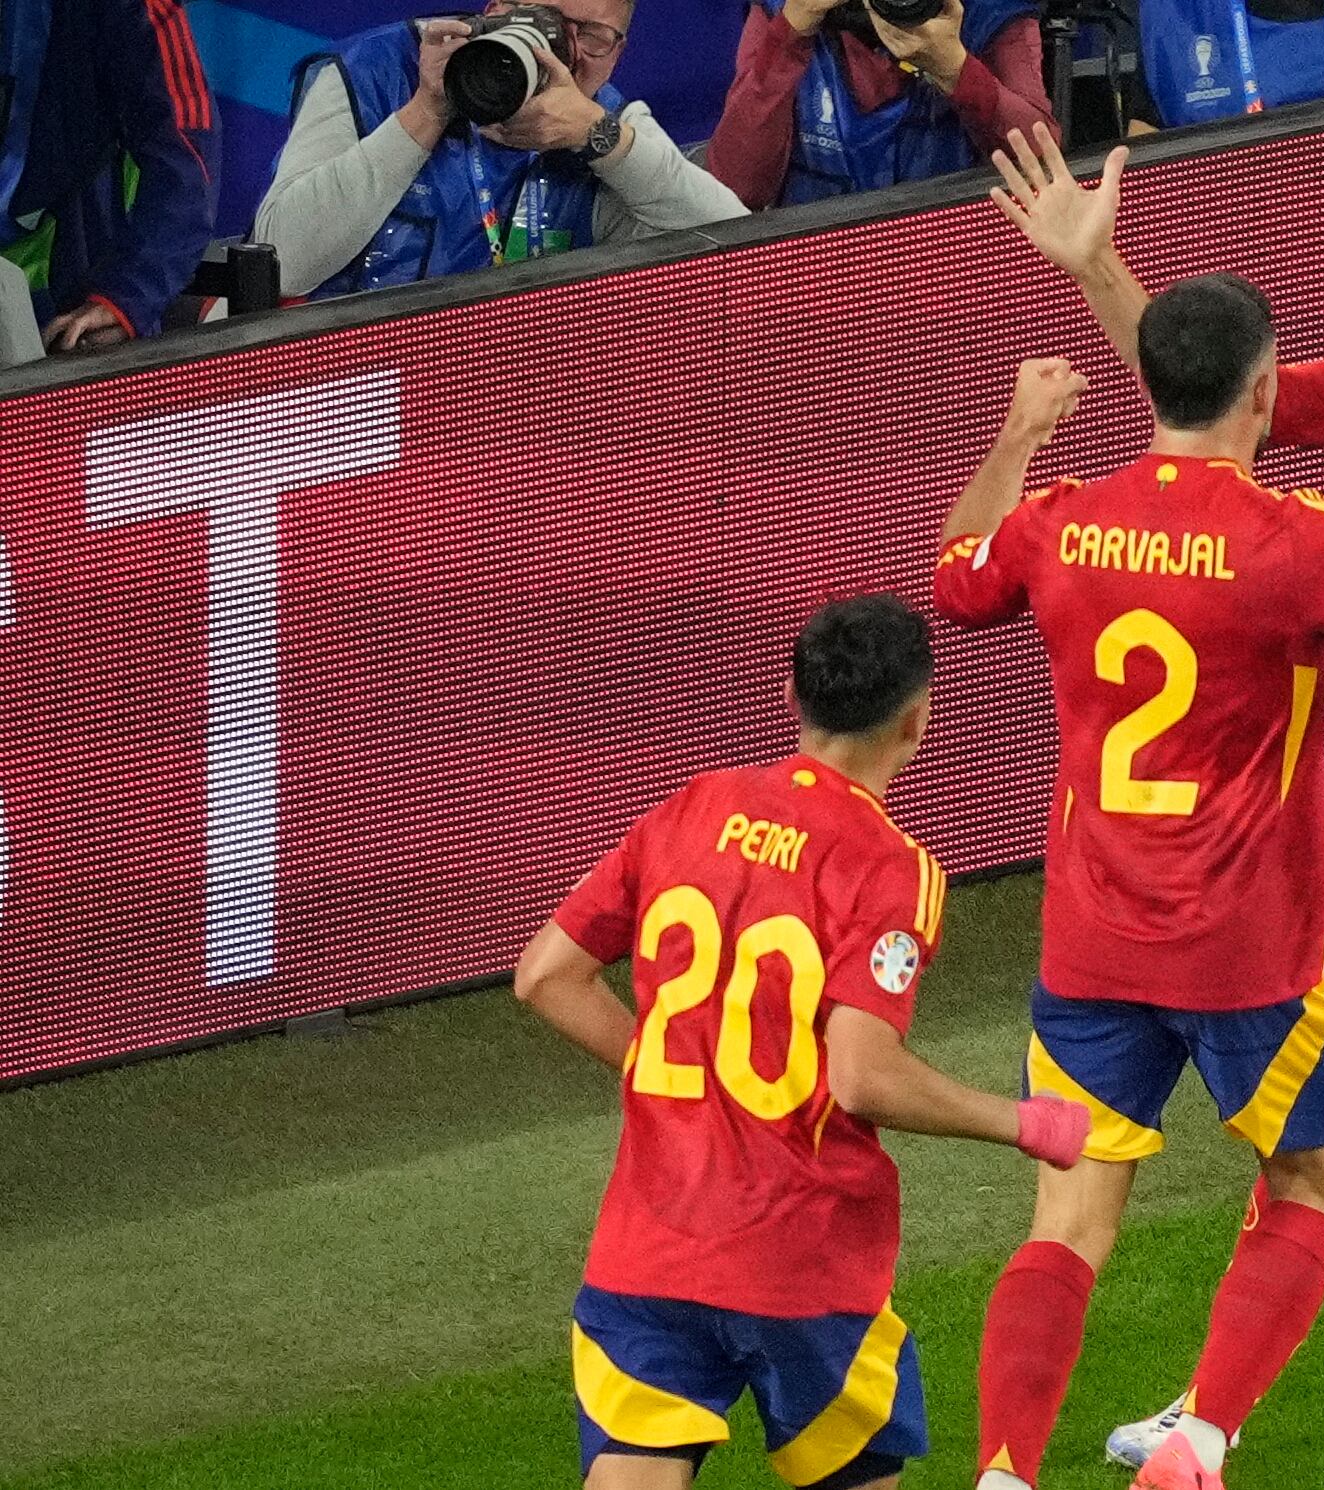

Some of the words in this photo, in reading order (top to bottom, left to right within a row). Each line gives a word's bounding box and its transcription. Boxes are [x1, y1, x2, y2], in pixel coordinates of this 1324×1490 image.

[1059, 522, 1236, 581] CARVAJAL
[0, 369, 401, 987] T
[1094, 608, 1200, 816] 2
[716, 812, 809, 874] PEDRI
[632, 884, 826, 1121] 20
